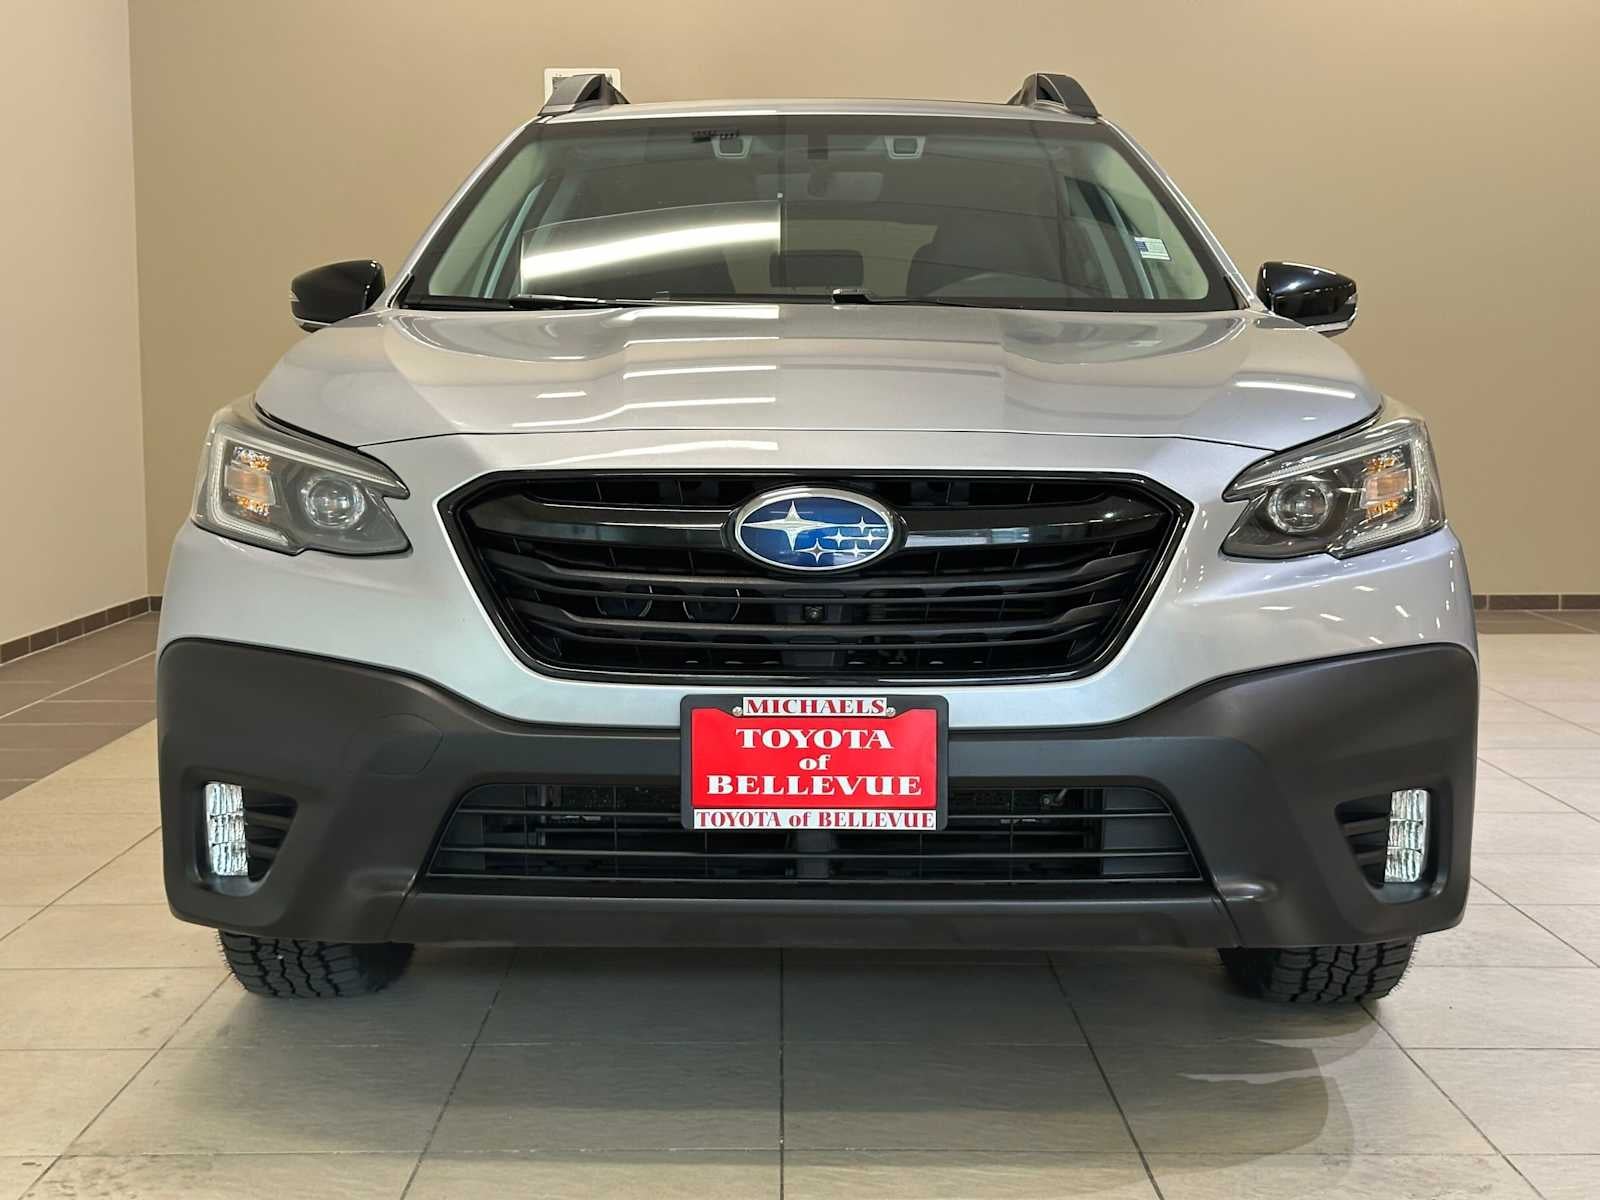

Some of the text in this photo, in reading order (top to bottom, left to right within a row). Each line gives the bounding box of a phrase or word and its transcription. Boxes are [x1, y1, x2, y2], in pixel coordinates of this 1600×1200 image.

[746, 699, 885, 714] MICHAELS
[736, 729, 893, 749] TOYOTA
[799, 754, 831, 771] of
[707, 775, 923, 796] BELLEVUE
[696, 811, 935, 828] TOYOTA of BELLEVUE
